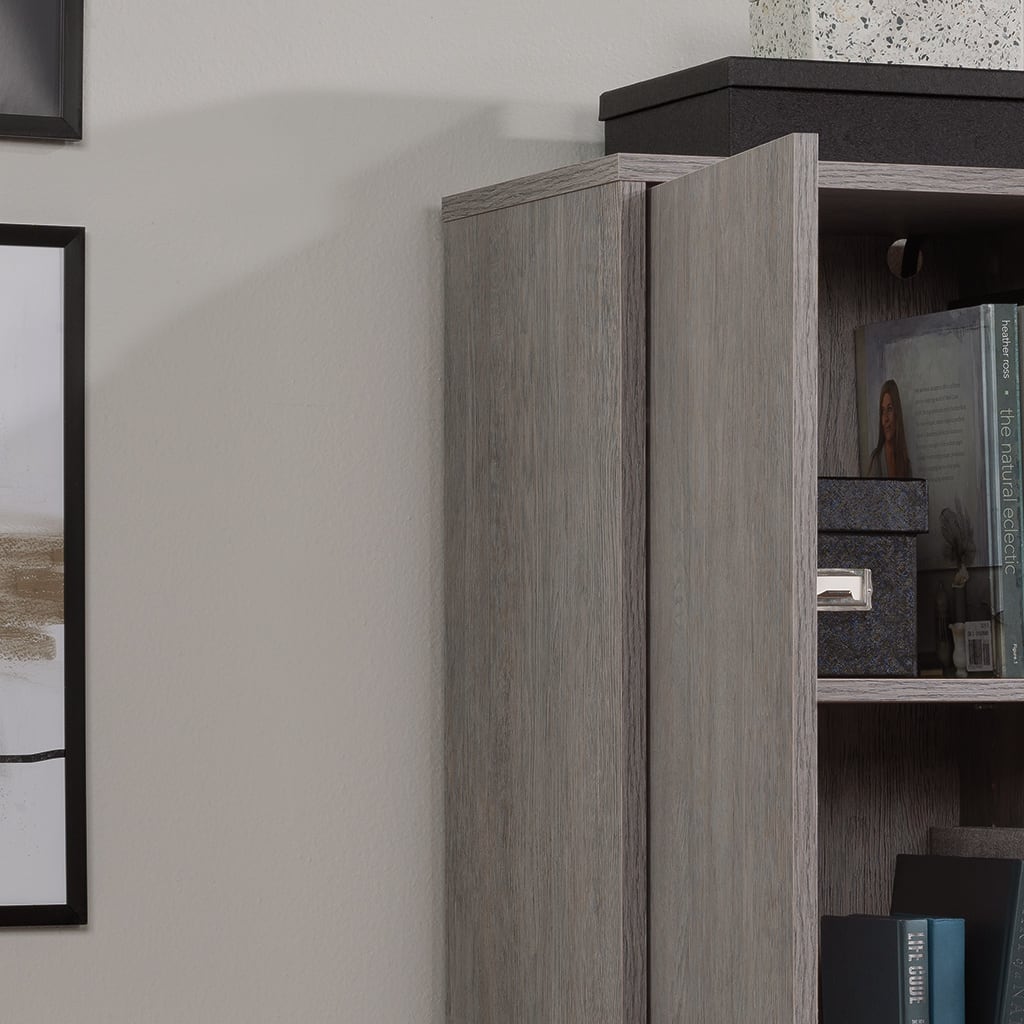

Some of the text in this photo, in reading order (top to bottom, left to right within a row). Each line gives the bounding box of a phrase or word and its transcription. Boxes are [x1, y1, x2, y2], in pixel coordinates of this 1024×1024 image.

[1000, 320, 1019, 575] heather ross the natural eclectic
[907, 932, 925, 962] LIFE
[908, 965, 925, 1005] CODE
